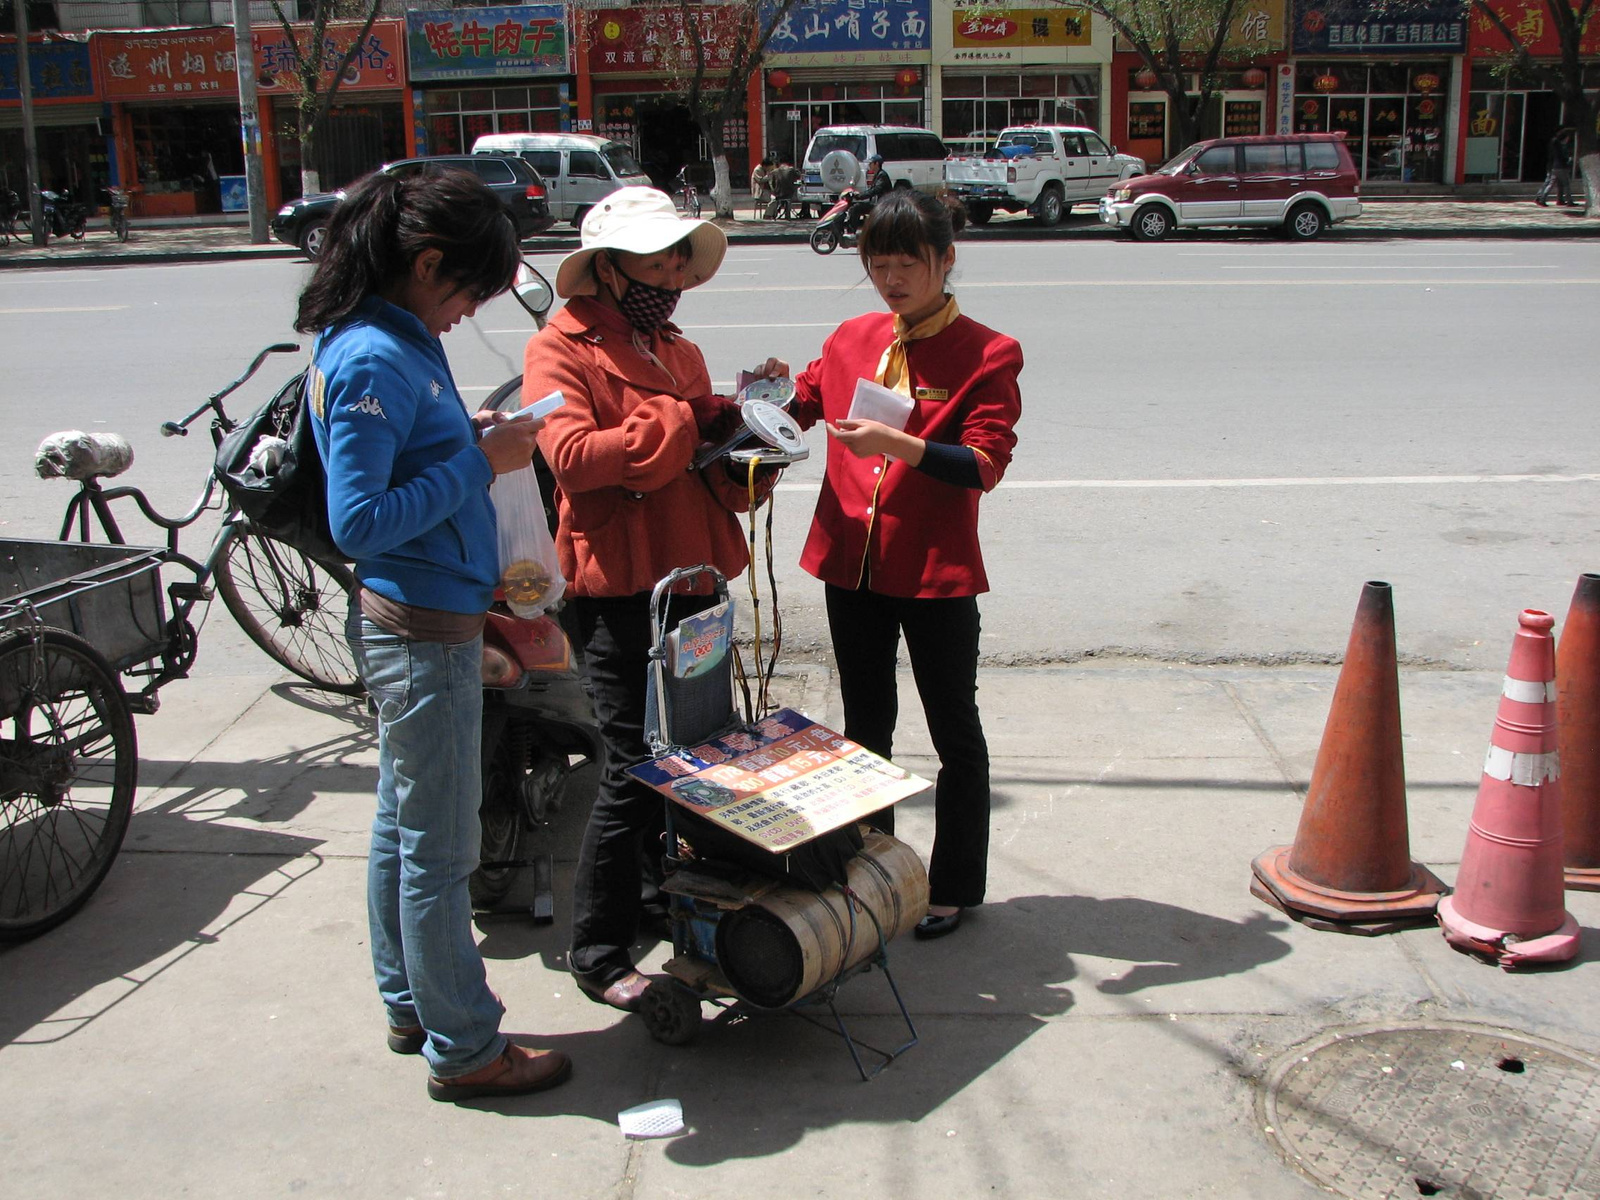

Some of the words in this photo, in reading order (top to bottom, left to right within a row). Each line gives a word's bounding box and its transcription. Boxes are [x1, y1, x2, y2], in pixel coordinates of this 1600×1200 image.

[425, 19, 559, 59] 牦牛肉干
[1241, 10, 1270, 41] 馆
